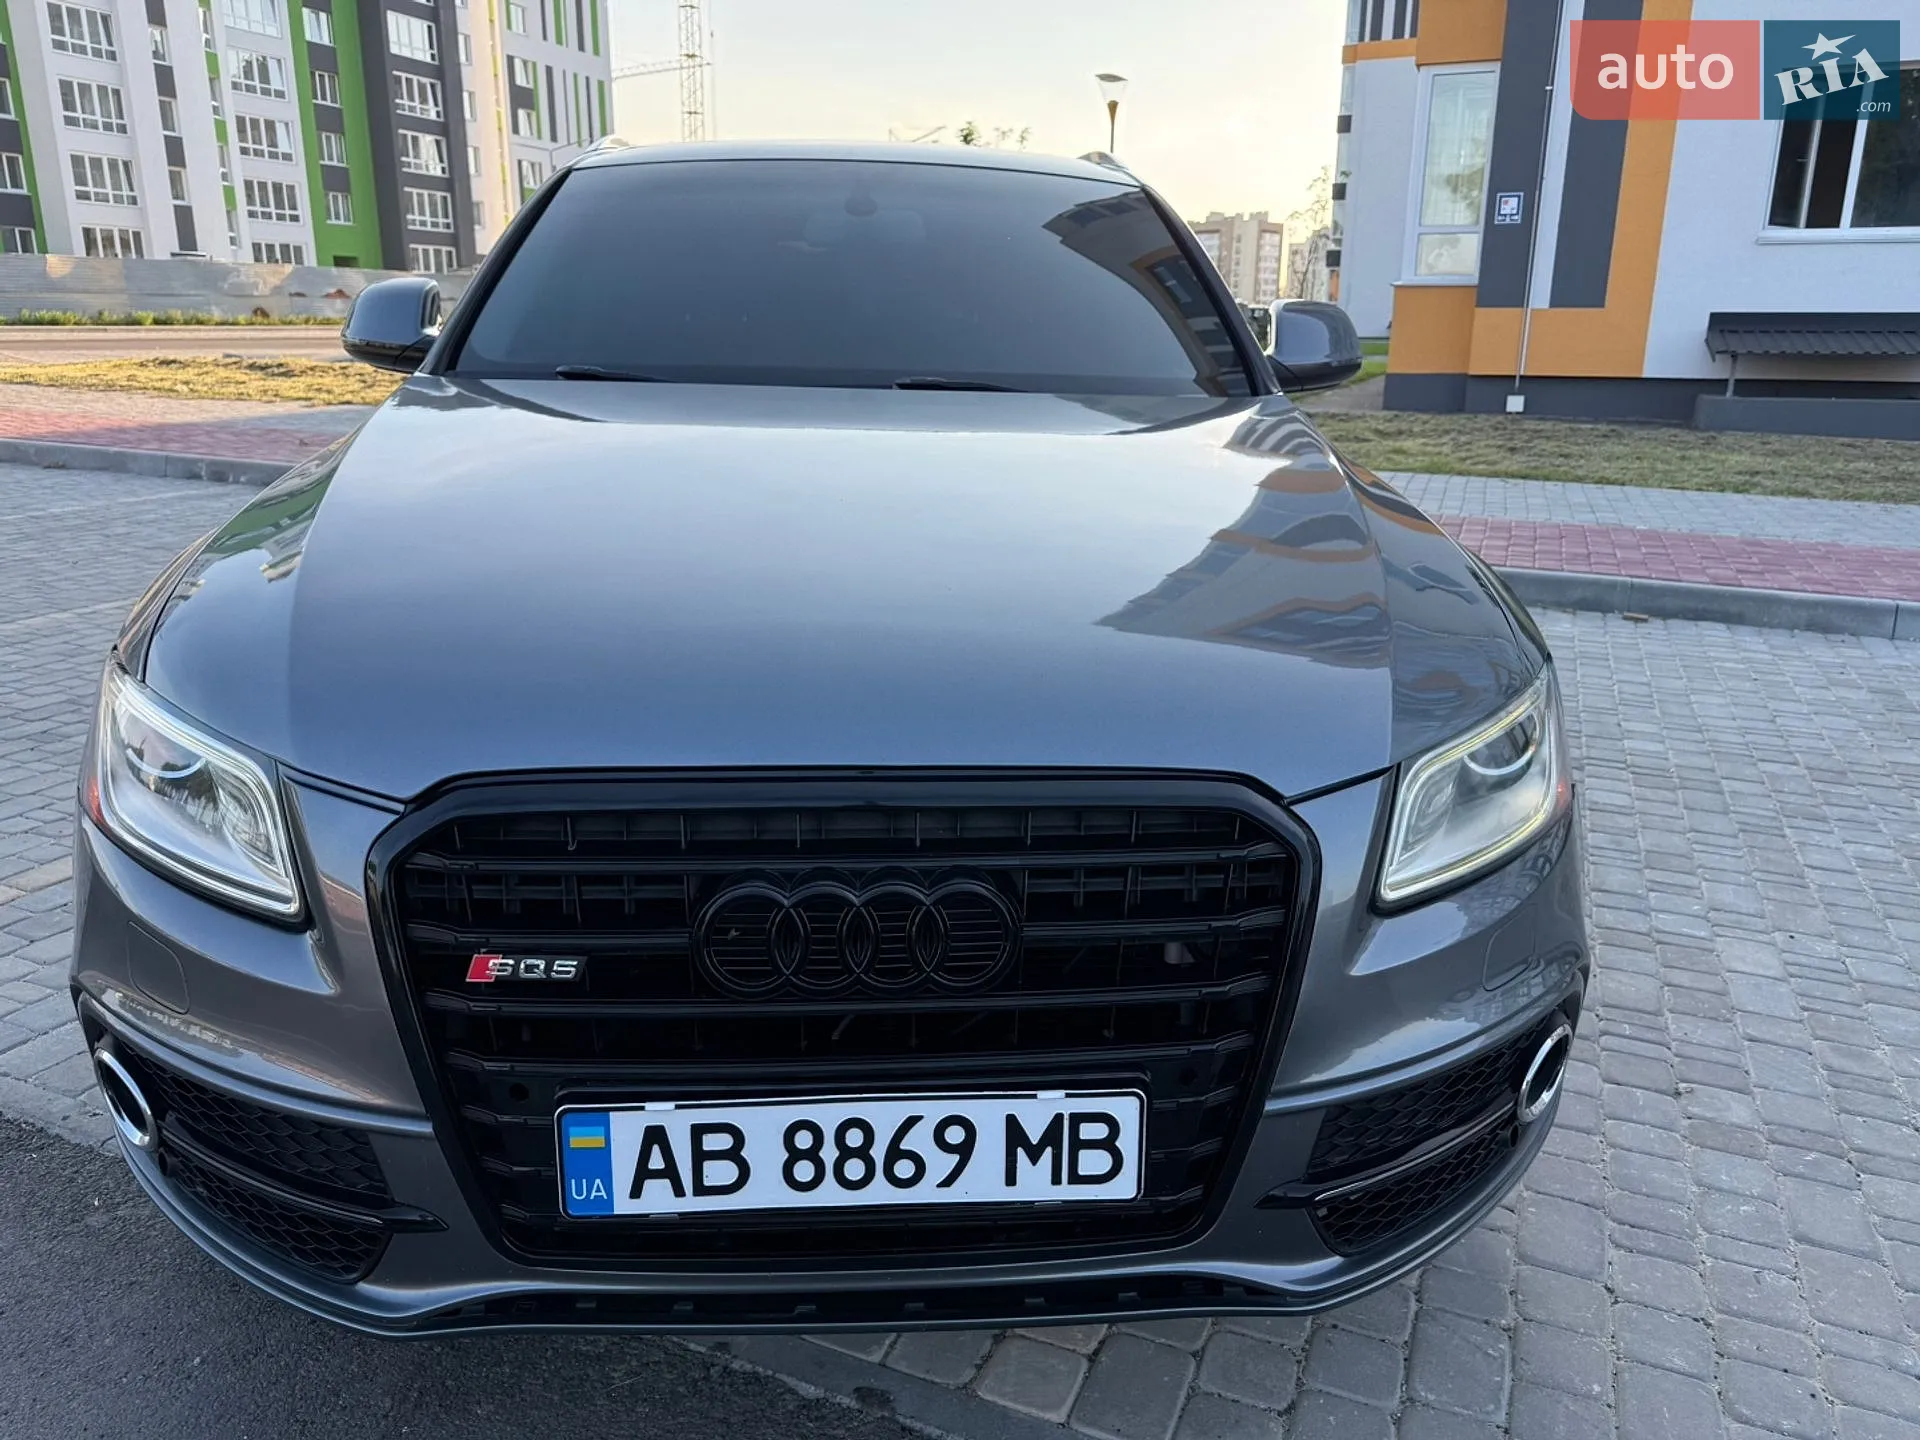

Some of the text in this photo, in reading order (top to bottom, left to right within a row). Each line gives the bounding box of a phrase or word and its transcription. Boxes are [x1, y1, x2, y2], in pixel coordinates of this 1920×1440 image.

[485, 958, 578, 979] SQ5
[629, 1111, 1125, 1199] AB 8869 MB
[570, 1178, 608, 1201] UA
